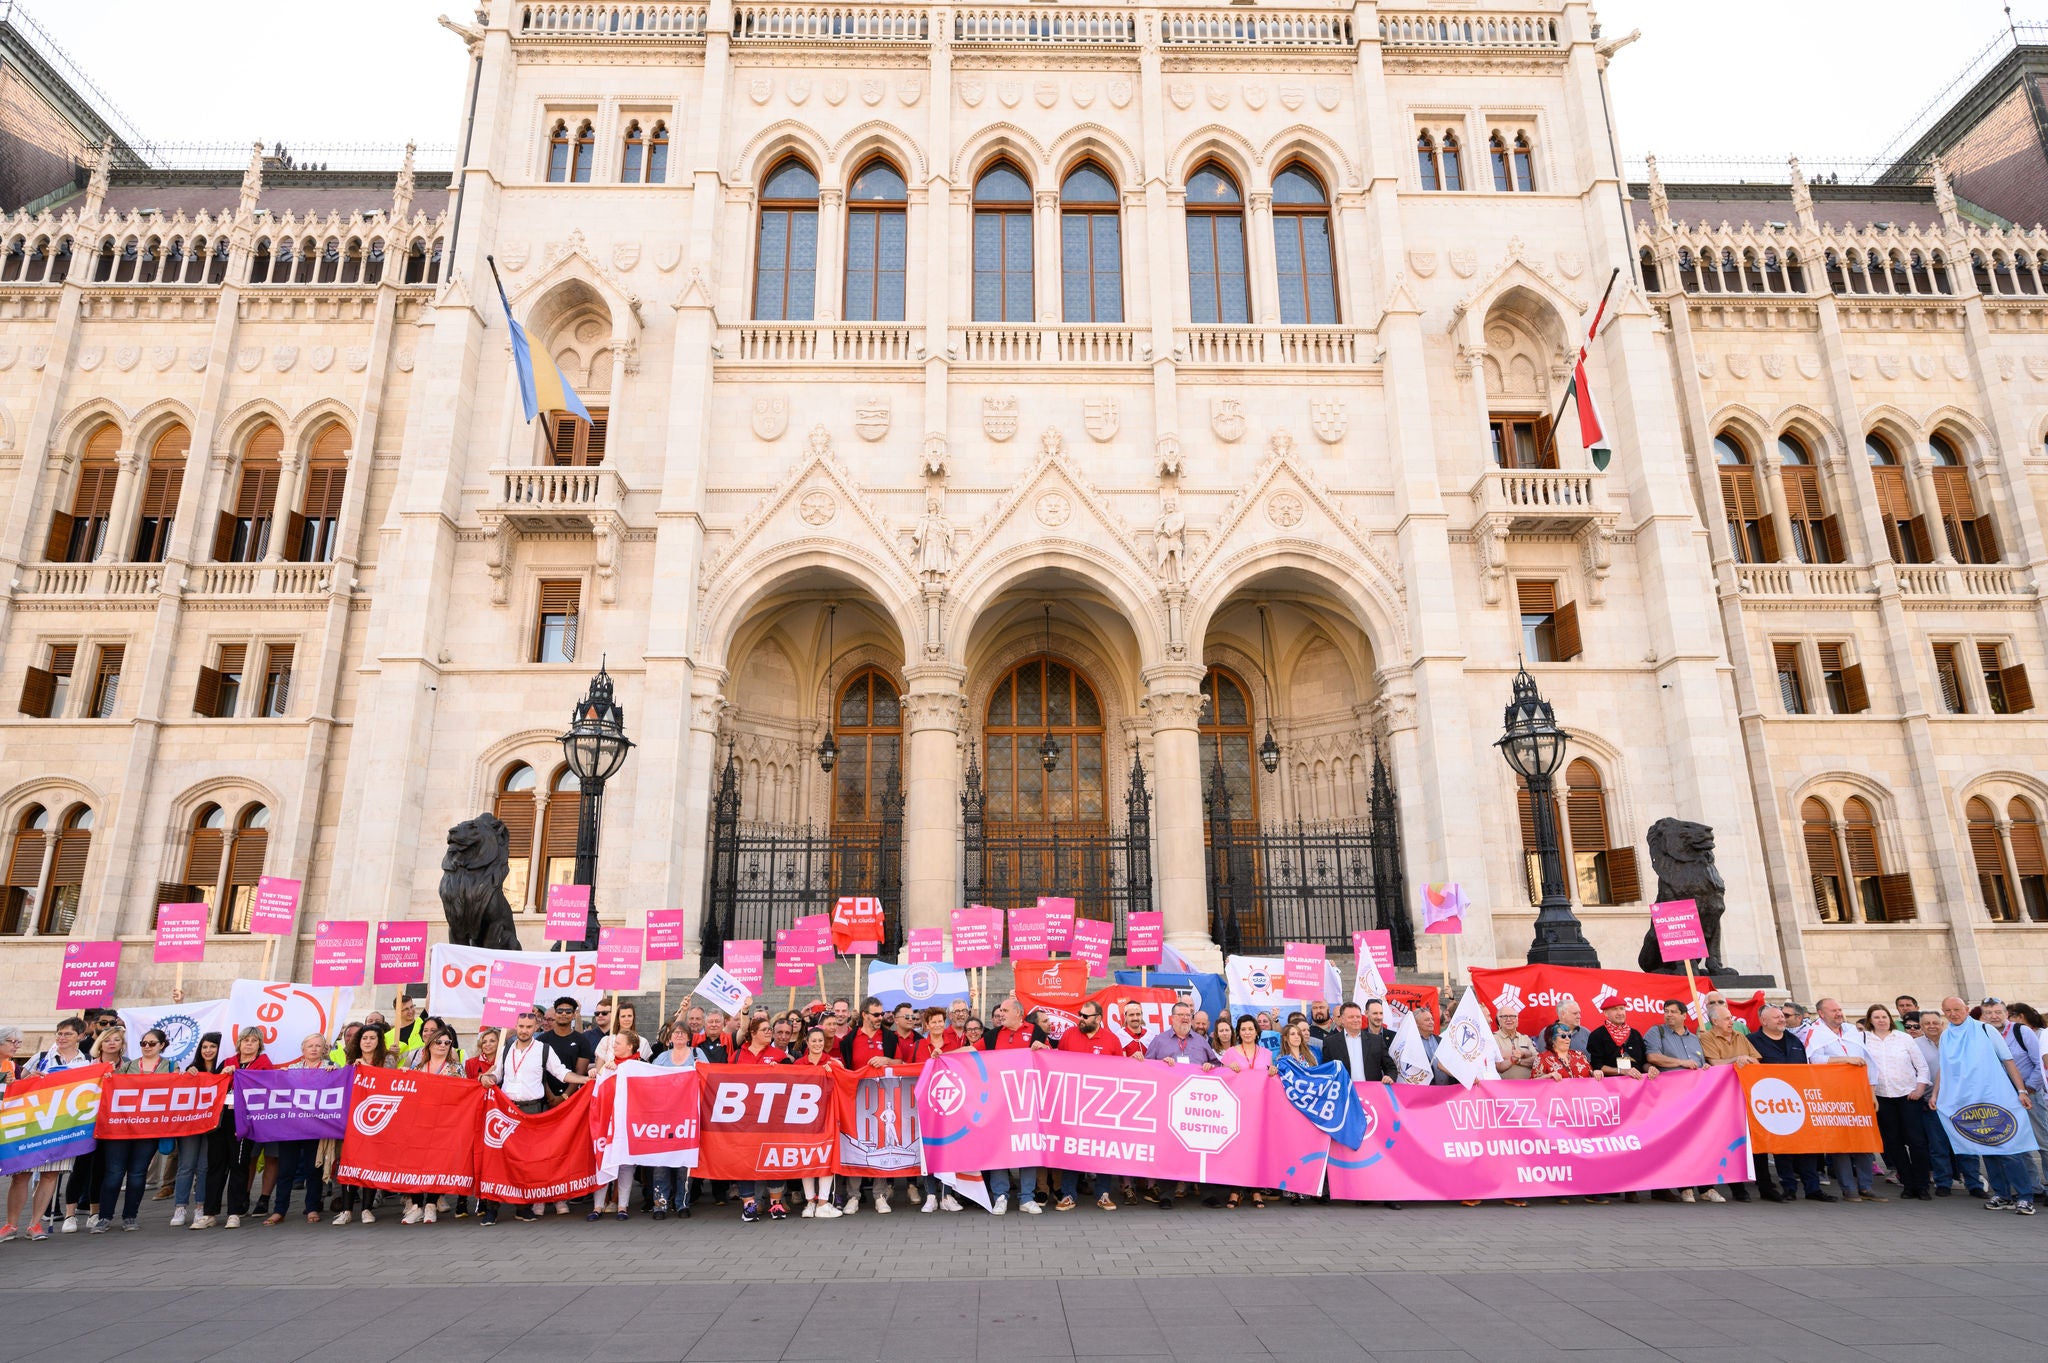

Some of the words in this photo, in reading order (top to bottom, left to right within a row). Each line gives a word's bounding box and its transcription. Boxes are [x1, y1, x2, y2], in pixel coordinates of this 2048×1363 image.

[1655, 914, 1695, 924] SOLIDARITY
[379, 936, 423, 944] SOLIDARITY
[1075, 935, 1096, 943] PEOPLE
[1663, 937, 1700, 947] WORKERS!
[1010, 943, 1047, 951] LISTENING?
[380, 961, 419, 969] WORKERS!
[1286, 956, 1322, 964] SOLIDARITY
[68, 980, 89, 988] JUST
[1287, 979, 1320, 987] WORKERS!
[69, 989, 103, 997] PROFIT!
[487, 997, 531, 1008] UNION-BUSTING
[1282, 1070, 1341, 1100] ACLVB
[111, 1085, 218, 1113] CCOO
[243, 1086, 345, 1111] CCOO
[936, 1087, 956, 1100] ETF
[1190, 1092, 1218, 1102] STOP
[1803, 1088, 1823, 1100] FGTE
[710, 1082, 822, 1124] BTB
[1000, 1069, 1158, 1133] WIZZ
[1286, 1086, 1335, 1120] GSLB
[1807, 1101, 1855, 1114] TRANSPORTS
[1, 1082, 102, 1139] EVG
[287, 1111, 296, 1119] la
[1184, 1106, 1224, 1118] UNION-
[1446, 1098, 1543, 1130] WIZZ
[1547, 1095, 1621, 1128] AIR!
[108, 1116, 150, 1124] servicios
[1810, 1115, 1873, 1127] ENVIRONNEMENT
[631, 1118, 697, 1139] ver.di
[1180, 1121, 1228, 1135] BUSTING
[28, 1141, 42, 1149] leben
[42, 1129, 86, 1145] Gemeinschaft
[1010, 1133, 1060, 1152] MUST
[1063, 1136, 1155, 1162] BEHAVE!
[1443, 1140, 1484, 1158] END
[1487, 1134, 1642, 1157] UNION-BUSTING
[763, 1144, 833, 1167] ABVV
[360, 1167, 391, 1183] ITALIANA
[392, 1172, 436, 1186] LAVORATORI
[436, 1174, 474, 1188] TRASPORTI
[1517, 1165, 1573, 1183] NOW!
[524, 1185, 568, 1199] LAVORATORI
